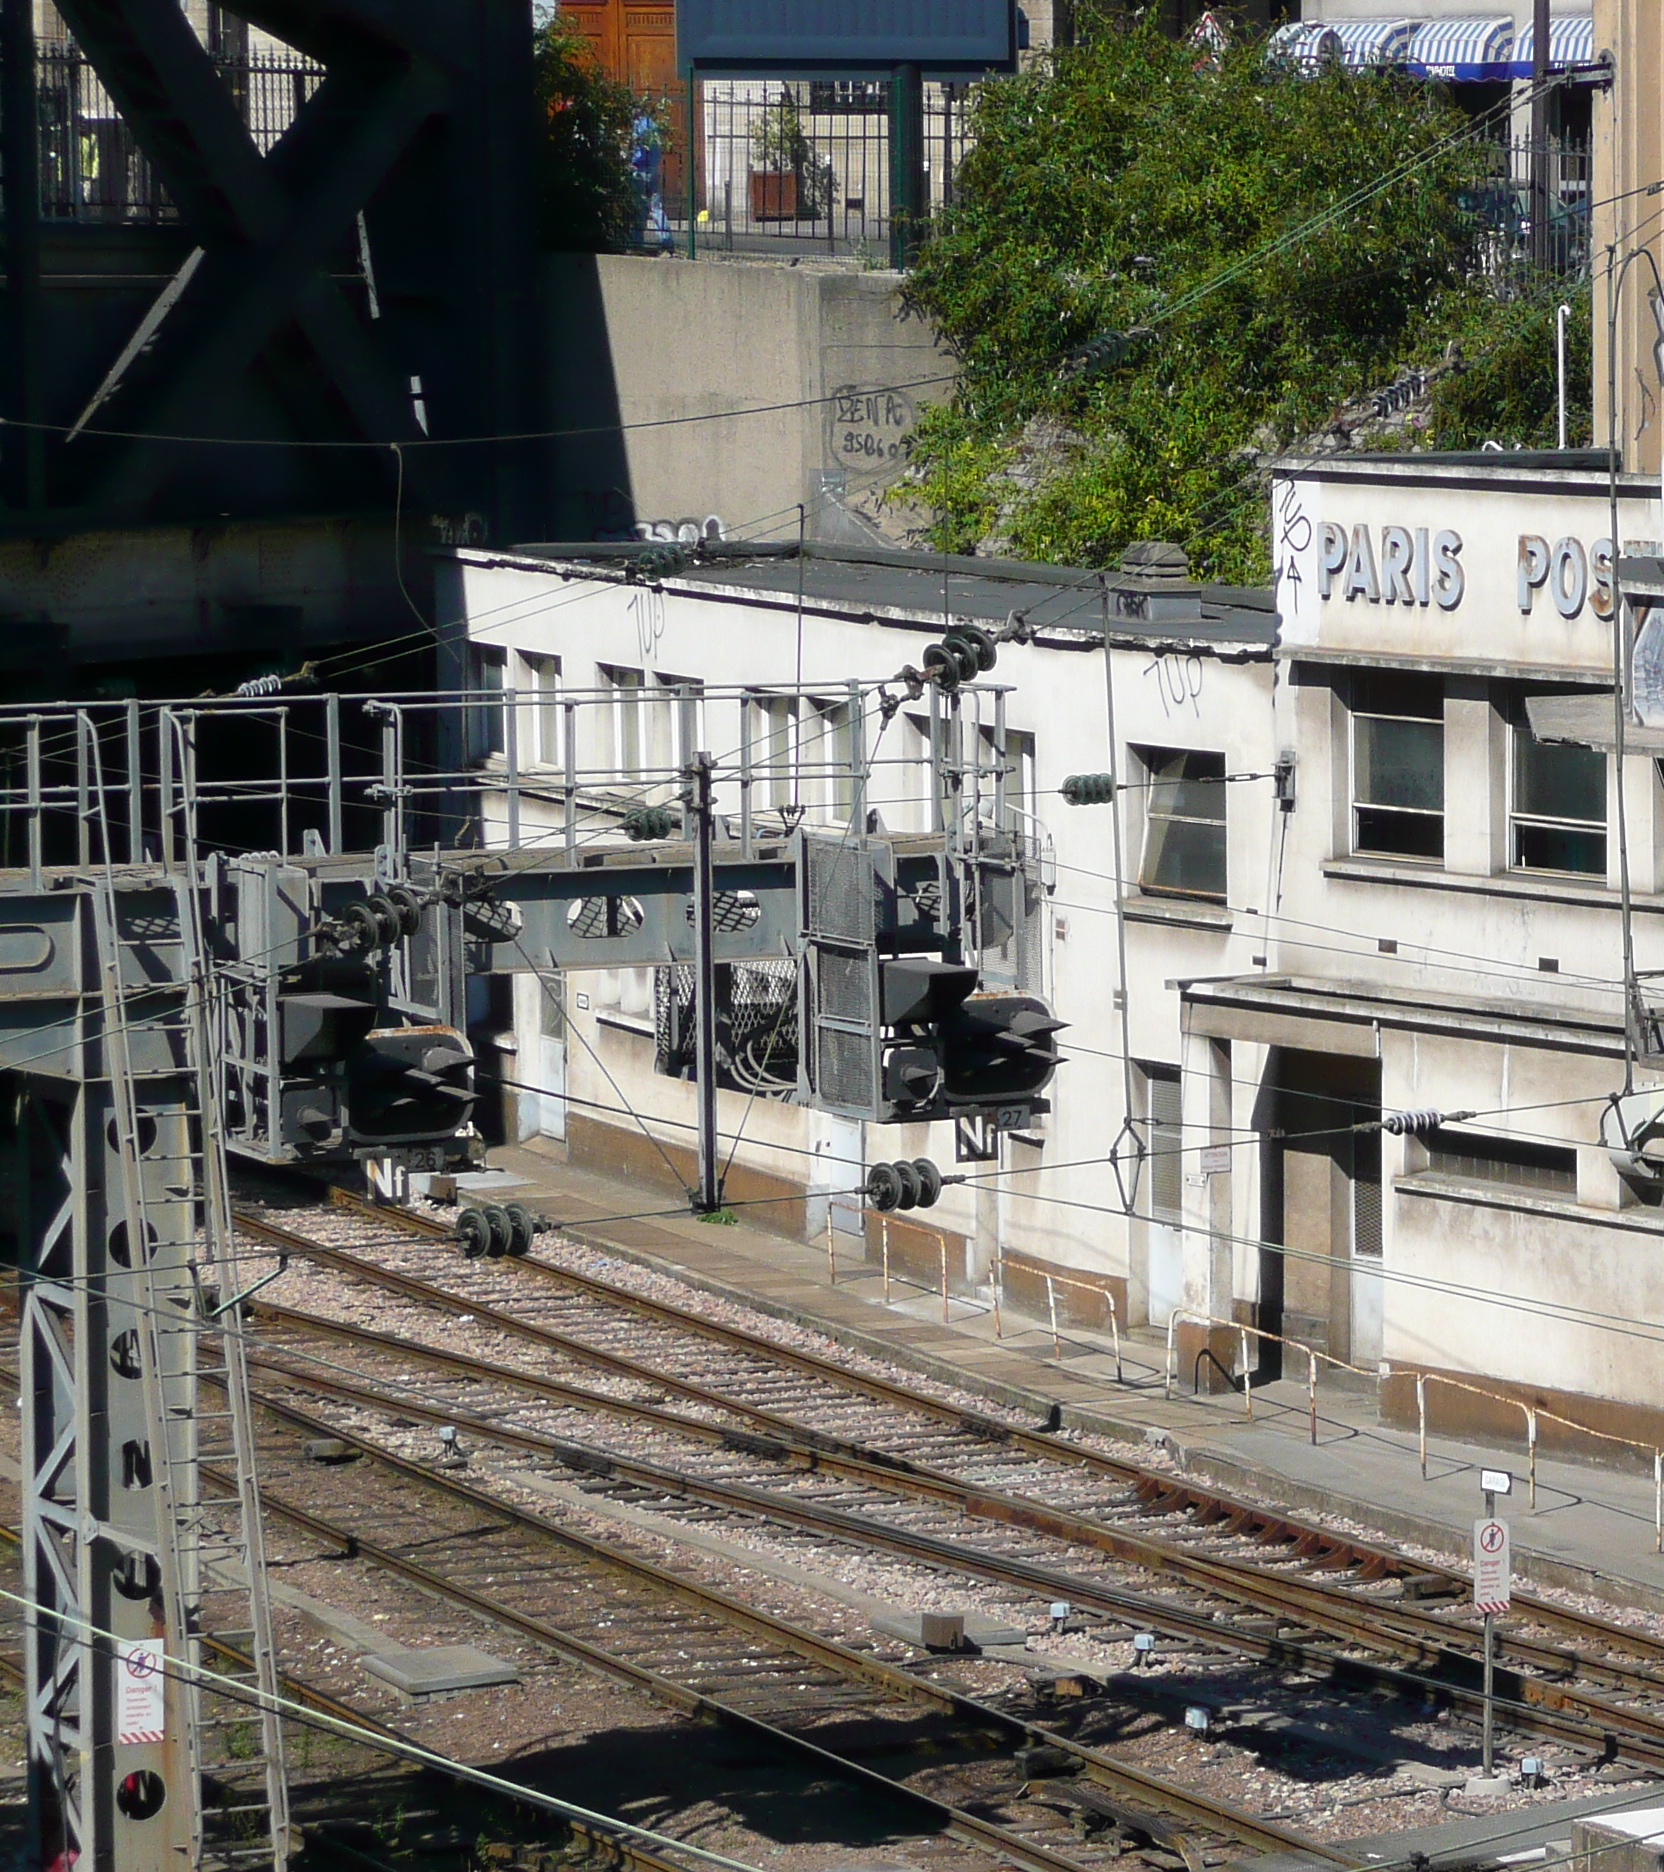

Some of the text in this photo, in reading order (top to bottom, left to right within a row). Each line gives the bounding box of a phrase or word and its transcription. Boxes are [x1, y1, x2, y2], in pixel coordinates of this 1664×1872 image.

[1316, 521, 1466, 613] PARIS
[1002, 1110, 1023, 1127] 27
[959, 1115, 996, 1156] Nf
[414, 1151, 437, 1169] 26
[366, 1157, 406, 1198] Nf
[126, 1686, 152, 1694] Danger
